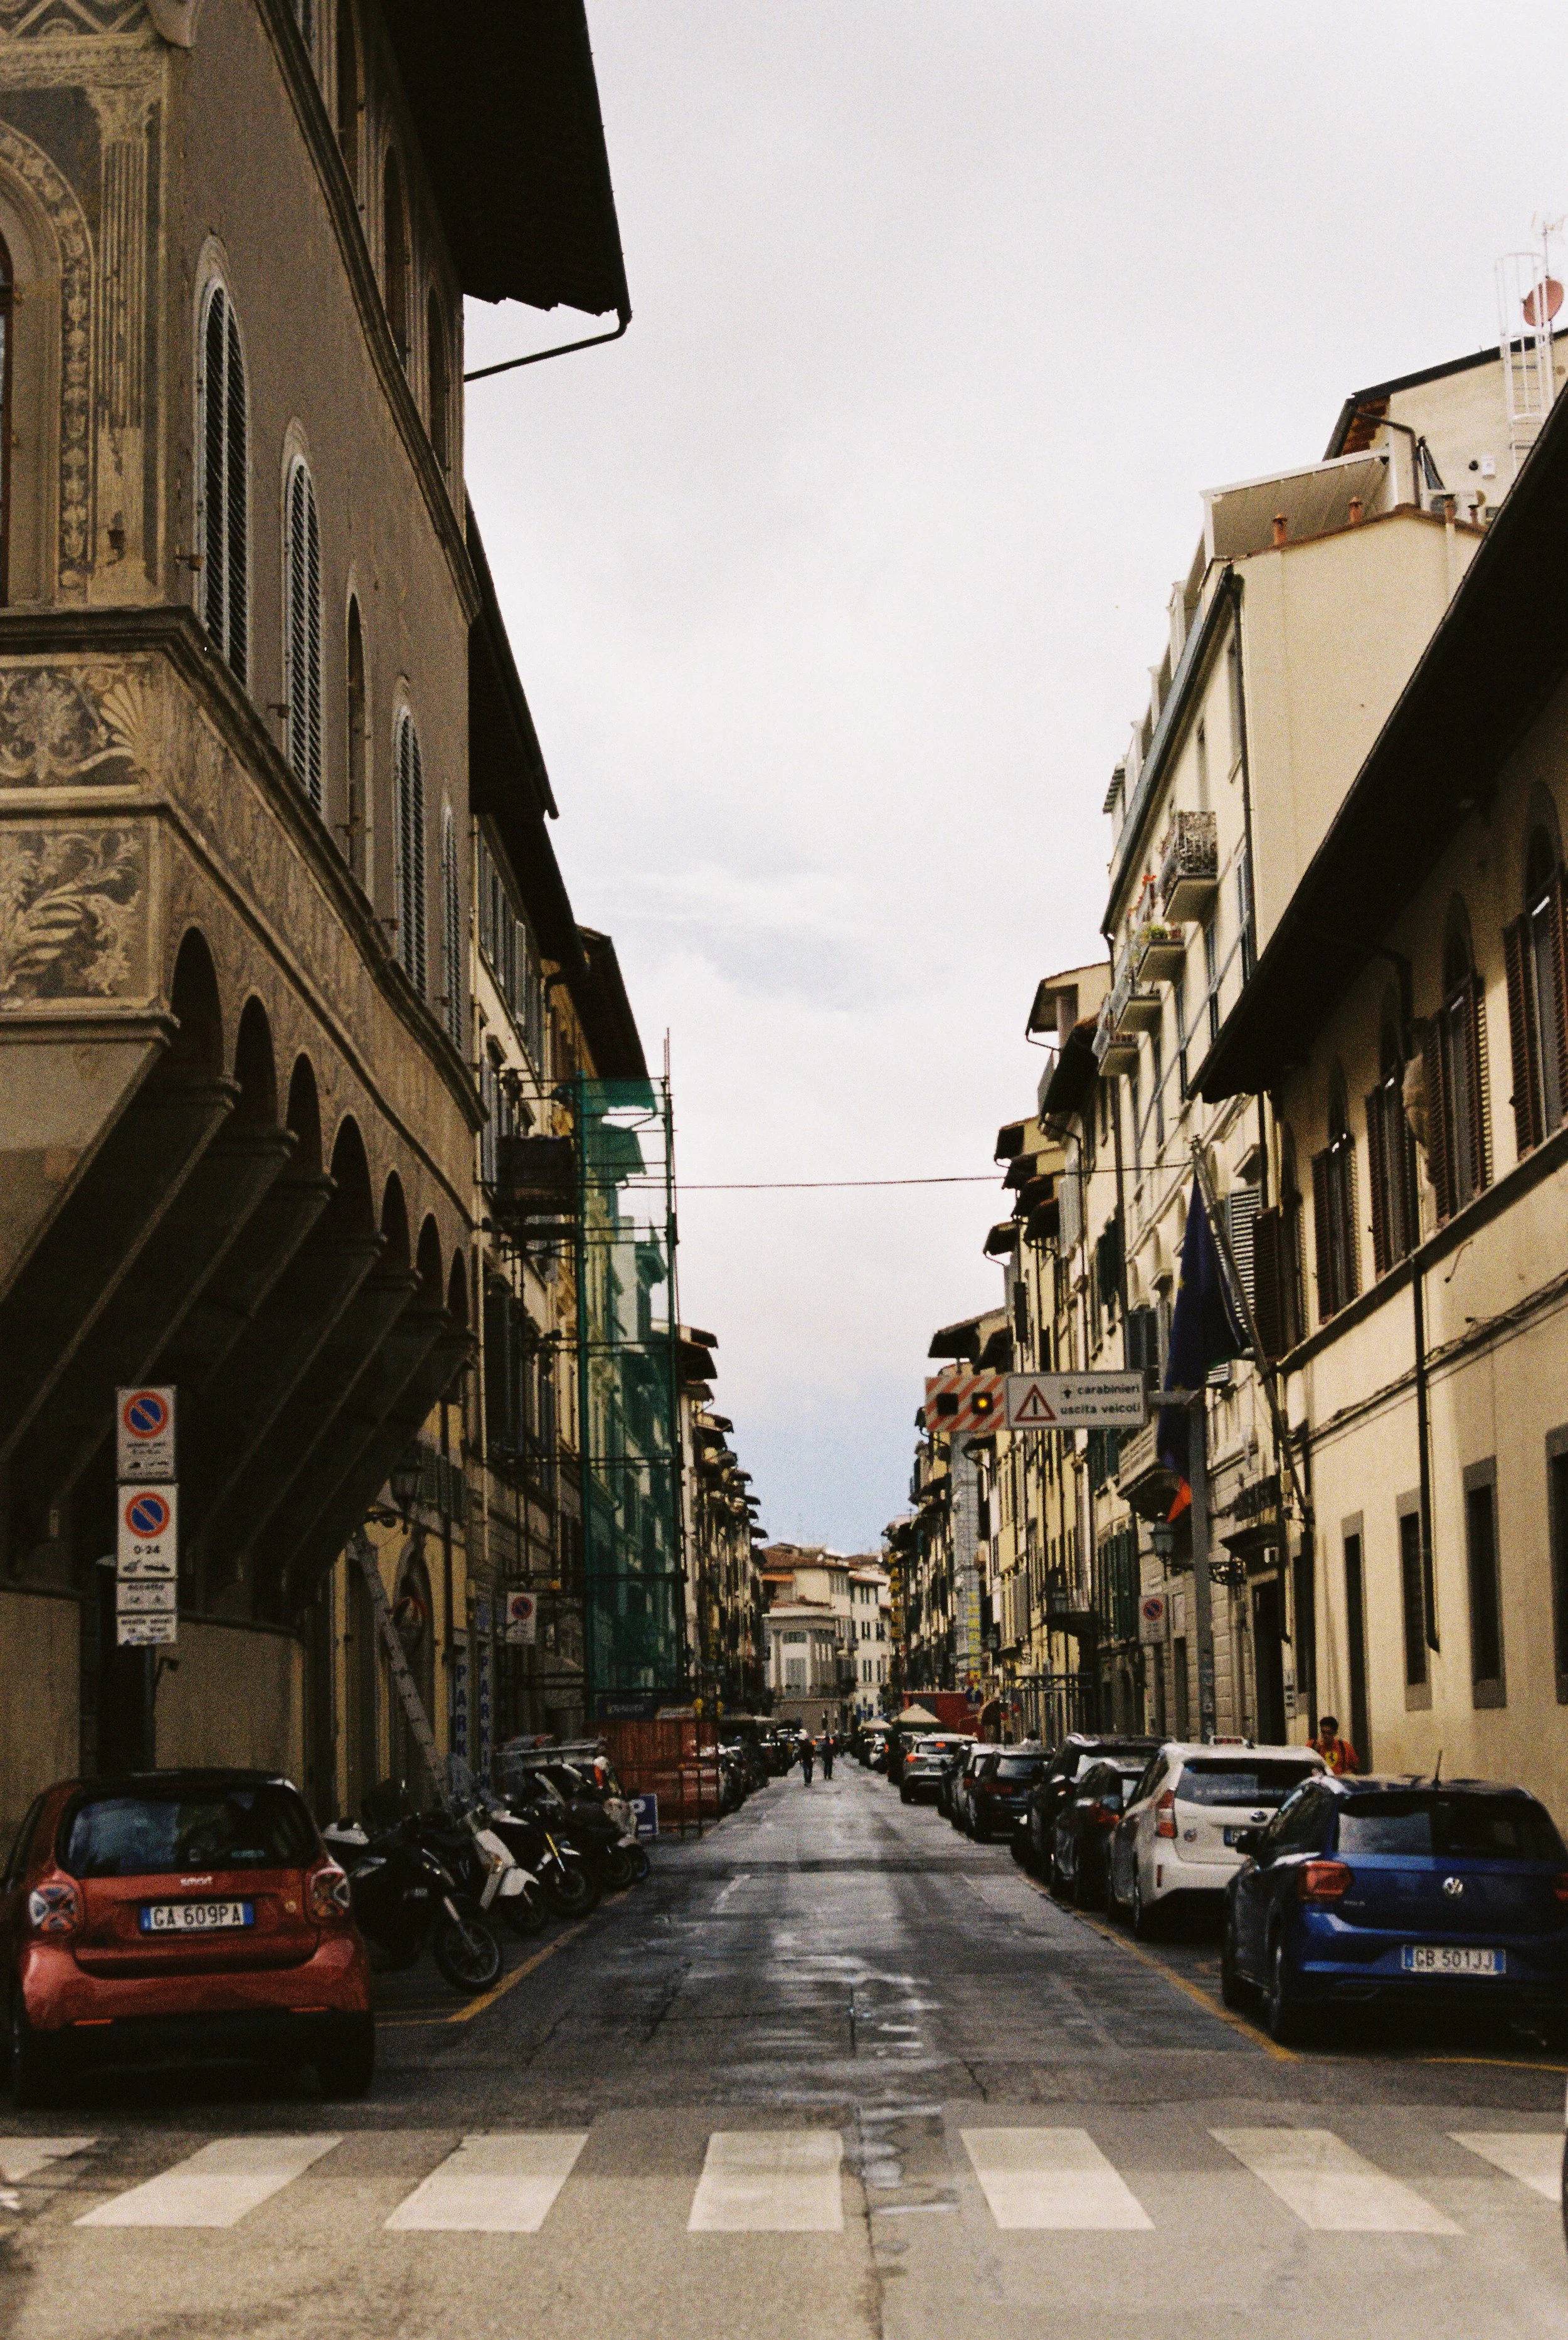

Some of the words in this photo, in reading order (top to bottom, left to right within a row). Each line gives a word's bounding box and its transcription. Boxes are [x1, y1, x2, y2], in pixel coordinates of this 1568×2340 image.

[1077, 1383, 1140, 1395] carabinieri
[1060, 1404, 1097, 1415] uscita
[1101, 1402, 1141, 1414] veicoli
